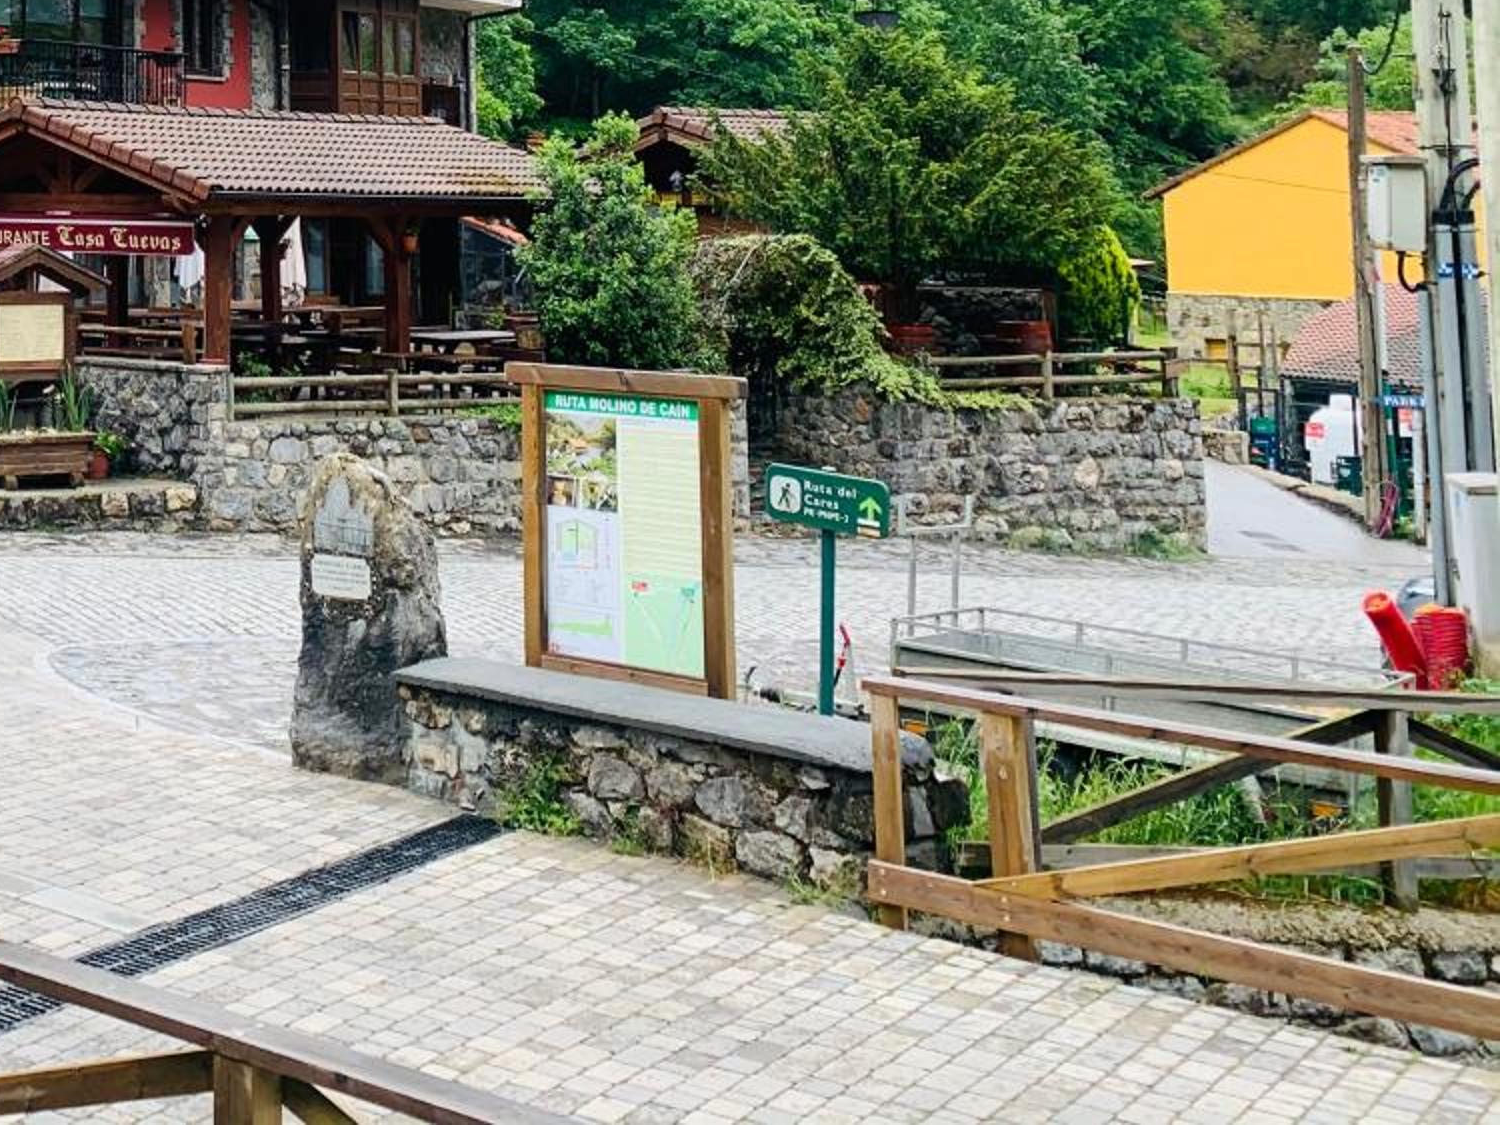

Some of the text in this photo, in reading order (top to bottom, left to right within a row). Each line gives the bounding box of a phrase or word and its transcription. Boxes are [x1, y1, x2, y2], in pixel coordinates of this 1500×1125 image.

[555, 394, 587, 410] RUTA
[589, 397, 637, 414] MOLINO
[639, 401, 658, 416] DE
[803, 479, 857, 500] Ruta del
[803, 493, 840, 510] Cares
